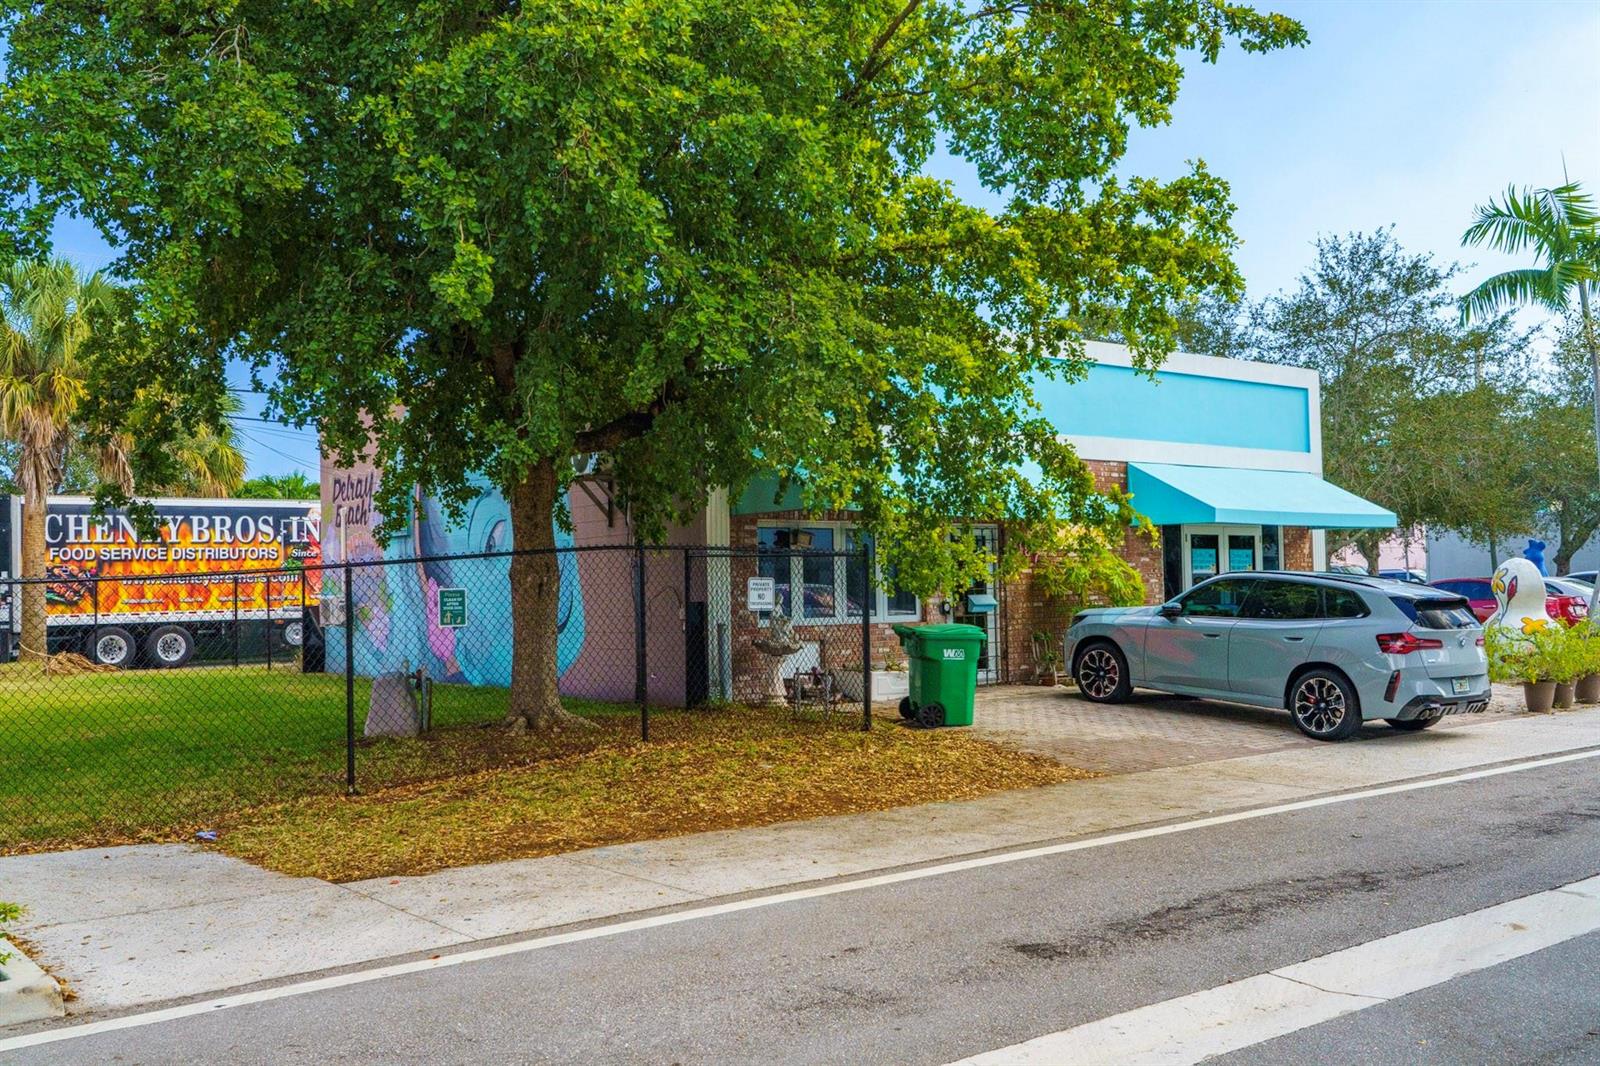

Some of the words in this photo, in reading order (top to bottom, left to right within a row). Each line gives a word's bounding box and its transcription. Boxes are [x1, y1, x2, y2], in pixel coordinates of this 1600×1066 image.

[333, 472, 374, 513] Delray
[335, 500, 369, 528] Bach
[45, 514, 184, 544] CHENY
[50, 548, 96, 560] FOOD
[100, 547, 168, 560] SERVICE
[172, 546, 278, 560] DISTRIBUTORS
[291, 548, 317, 557] Since
[943, 648, 965, 658] WM
